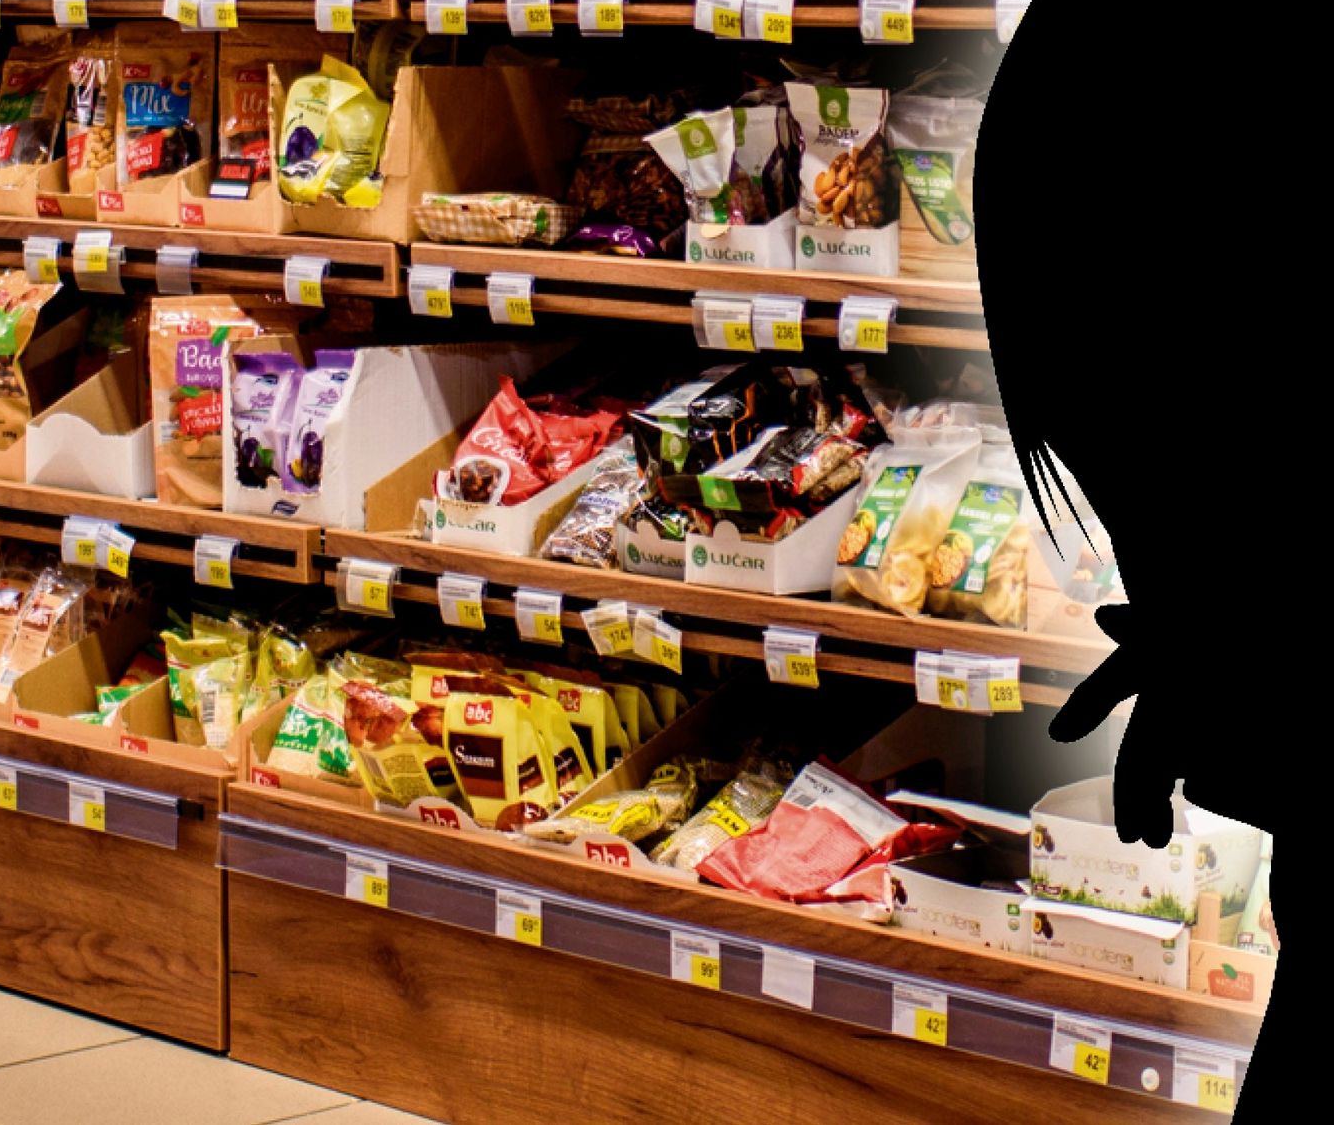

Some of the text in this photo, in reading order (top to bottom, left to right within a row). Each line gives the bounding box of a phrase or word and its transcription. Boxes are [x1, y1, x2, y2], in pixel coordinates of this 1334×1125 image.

[431, 678, 449, 697] ab
[925, 1017, 940, 1035] 42
[1084, 1052, 1100, 1070] 42
